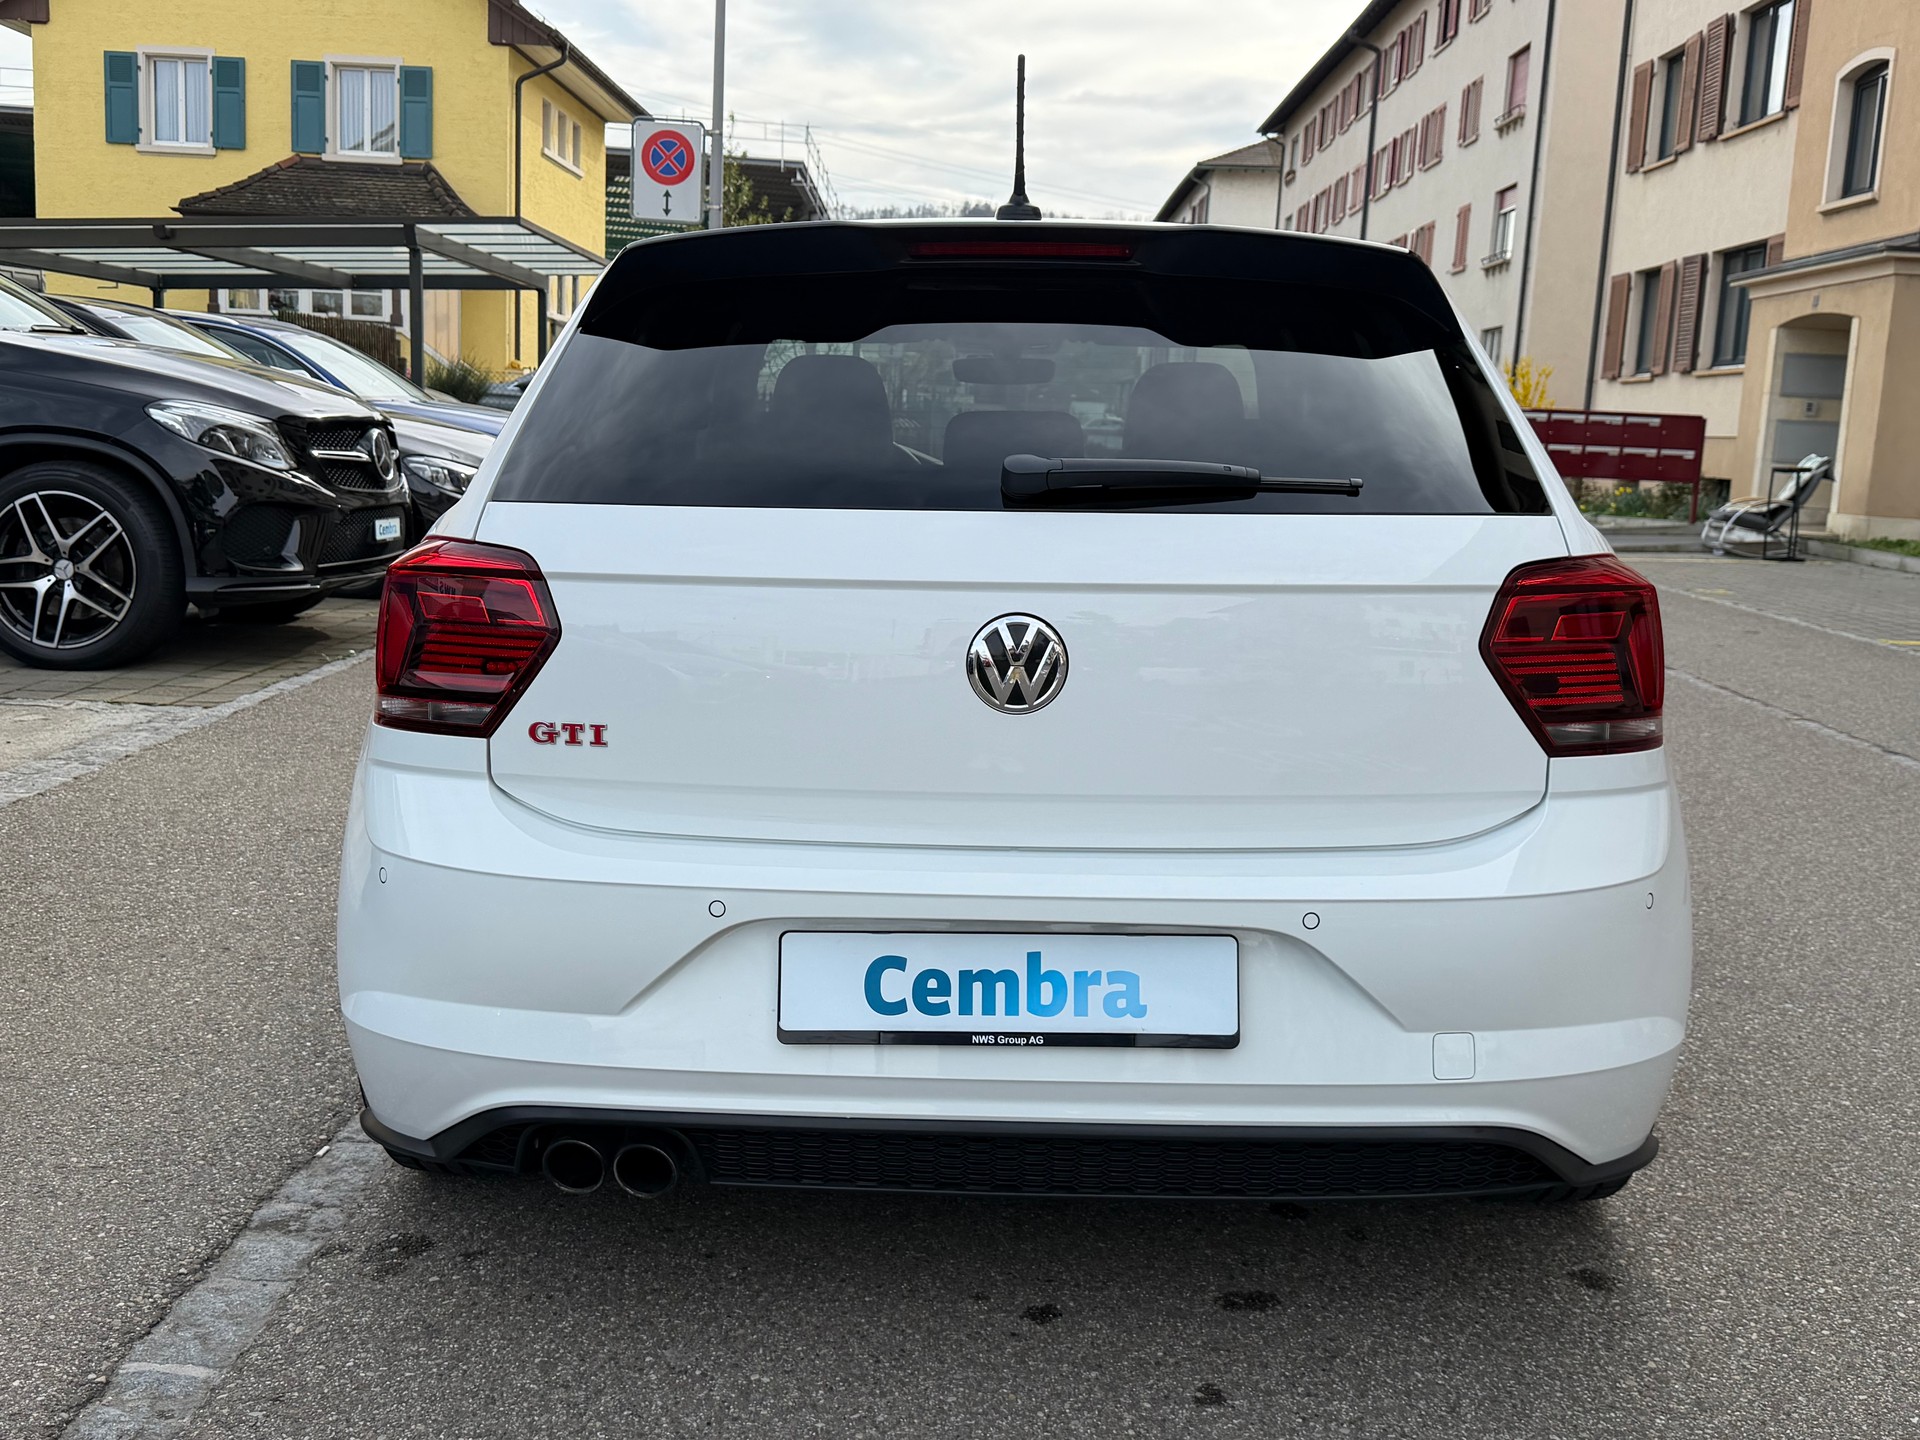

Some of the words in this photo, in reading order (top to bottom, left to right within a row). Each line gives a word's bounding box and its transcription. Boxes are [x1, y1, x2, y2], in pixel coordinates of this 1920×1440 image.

[528, 721, 608, 747] GTI
[863, 950, 1148, 1019] Cembra
[972, 1034, 995, 1044] NWS
[997, 1035, 1027, 1046] Group
[1028, 1035, 1044, 1045] AG
